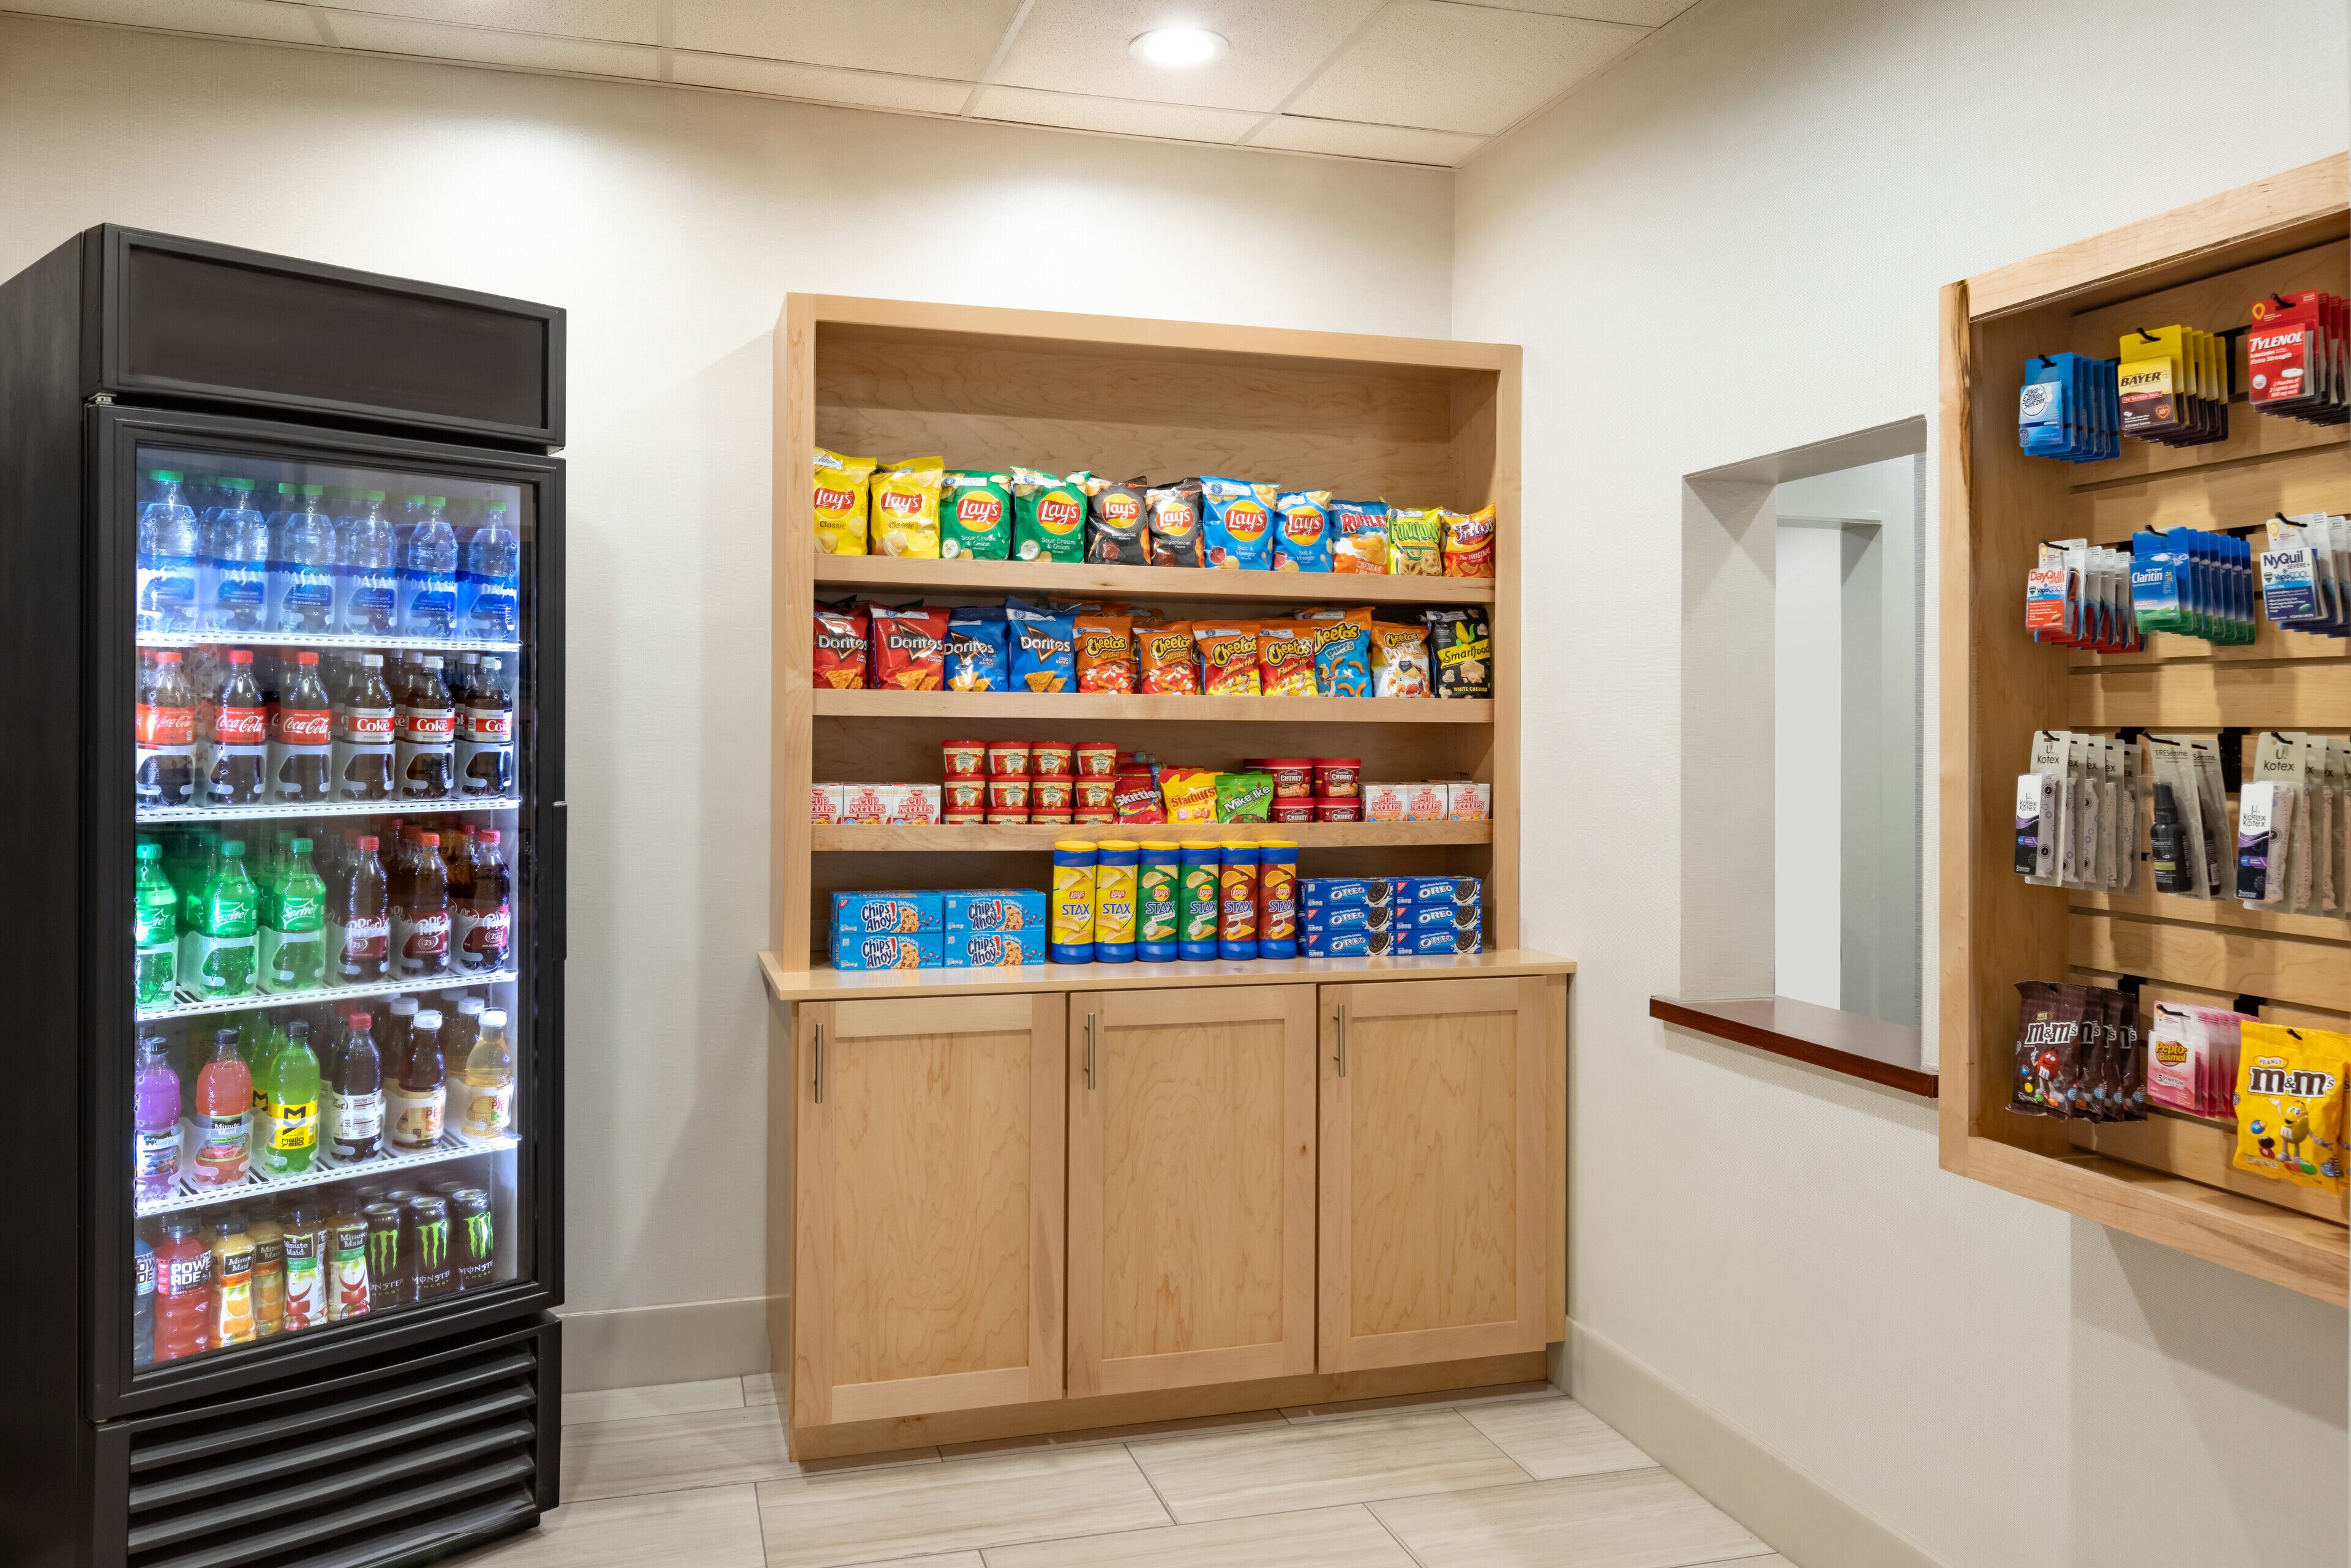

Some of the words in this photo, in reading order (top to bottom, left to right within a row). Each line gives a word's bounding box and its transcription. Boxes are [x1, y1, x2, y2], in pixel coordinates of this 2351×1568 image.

[2249, 332, 2304, 353] TYLENOL
[2267, 353, 2292, 362] Strength
[2121, 372, 2161, 386] BAYER
[816, 489, 852, 510] Lay's
[885, 493, 918, 512] Lay's
[960, 500, 999, 523] Lay's
[1041, 500, 1077, 525] Lay's
[1106, 502, 1136, 519] Lay's
[1160, 509, 1190, 528] Lay's
[1229, 511, 1265, 532] Lay's
[1288, 514, 1321, 536] Lay's
[1453, 518, 1494, 543] Fritos
[1469, 547, 1490, 560] ORIGINAL
[2264, 550, 2303, 569] NyQuil
[285, 569, 330, 588] DASANI
[2132, 572, 2162, 583] Claritin
[819, 636, 867, 649] Doritos
[891, 636, 942, 649] Doritos
[1022, 636, 1070, 652] Doritos
[1087, 636, 1127, 655] Cheetos
[1152, 635, 1191, 658] Cheetos
[1385, 632, 1418, 648] Cheetos
[944, 639, 994, 655] Doritos
[1213, 637, 1256, 665] Cheetos
[1267, 639, 1311, 665] Cheetos
[1442, 643, 1489, 663] Smartfood
[1166, 651, 1187, 661] Crunchy
[157, 716, 191, 727] Coca-Cola
[216, 715, 264, 732] Coca-Cola
[283, 717, 329, 733] Coca-Cola
[357, 719, 389, 731] Coke
[417, 719, 449, 731] Coke
[2038, 755, 2060, 764] kotex
[2264, 760, 2294, 771] kotex
[1114, 791, 1161, 808] Skittles
[1223, 795, 1251, 812] Mike
[1411, 801, 1442, 811] NOODLES
[1454, 801, 1484, 810] NOODLES
[850, 805, 886, 814] NOODLES
[899, 805, 934, 814] NOODLES
[1371, 802, 1402, 811] NOODLES
[1070, 891, 1084, 899] Lay's
[1154, 889, 1169, 898] Lay's
[1330, 887, 1365, 901] OREO
[1419, 885, 1452, 898] OREO
[283, 907, 313, 918] Sprite
[861, 904, 890, 921] Chips
[969, 902, 996, 920] Chips
[1062, 904, 1090, 915] STAX
[1103, 904, 1130, 914] STAX
[1146, 902, 1174, 913] STAX
[1191, 901, 1217, 913] STAX
[1225, 901, 1253, 912] STAX
[1269, 900, 1294, 912] STAX
[358, 918, 370, 928] Dr
[429, 917, 441, 926] Dr
[1330, 912, 1364, 926] OREO
[1419, 910, 1452, 923] OREO
[347, 919, 380, 936] Pepper
[898, 936, 919, 948] ORIGINAL
[967, 938, 995, 955] Chips
[1331, 937, 1365, 951] OREO
[1420, 935, 1453, 948] OREO
[862, 940, 890, 957] Chips
[2156, 1041, 2187, 1054] Pepto-
[2160, 1053, 2186, 1062] Bismol
[2162, 1075, 2184, 1086] SYMPTOM
[340, 1231, 366, 1241] Minute
[345, 1239, 363, 1247] Maid
[228, 1256, 252, 1265] Minute
[171, 1271, 201, 1285] ADE
